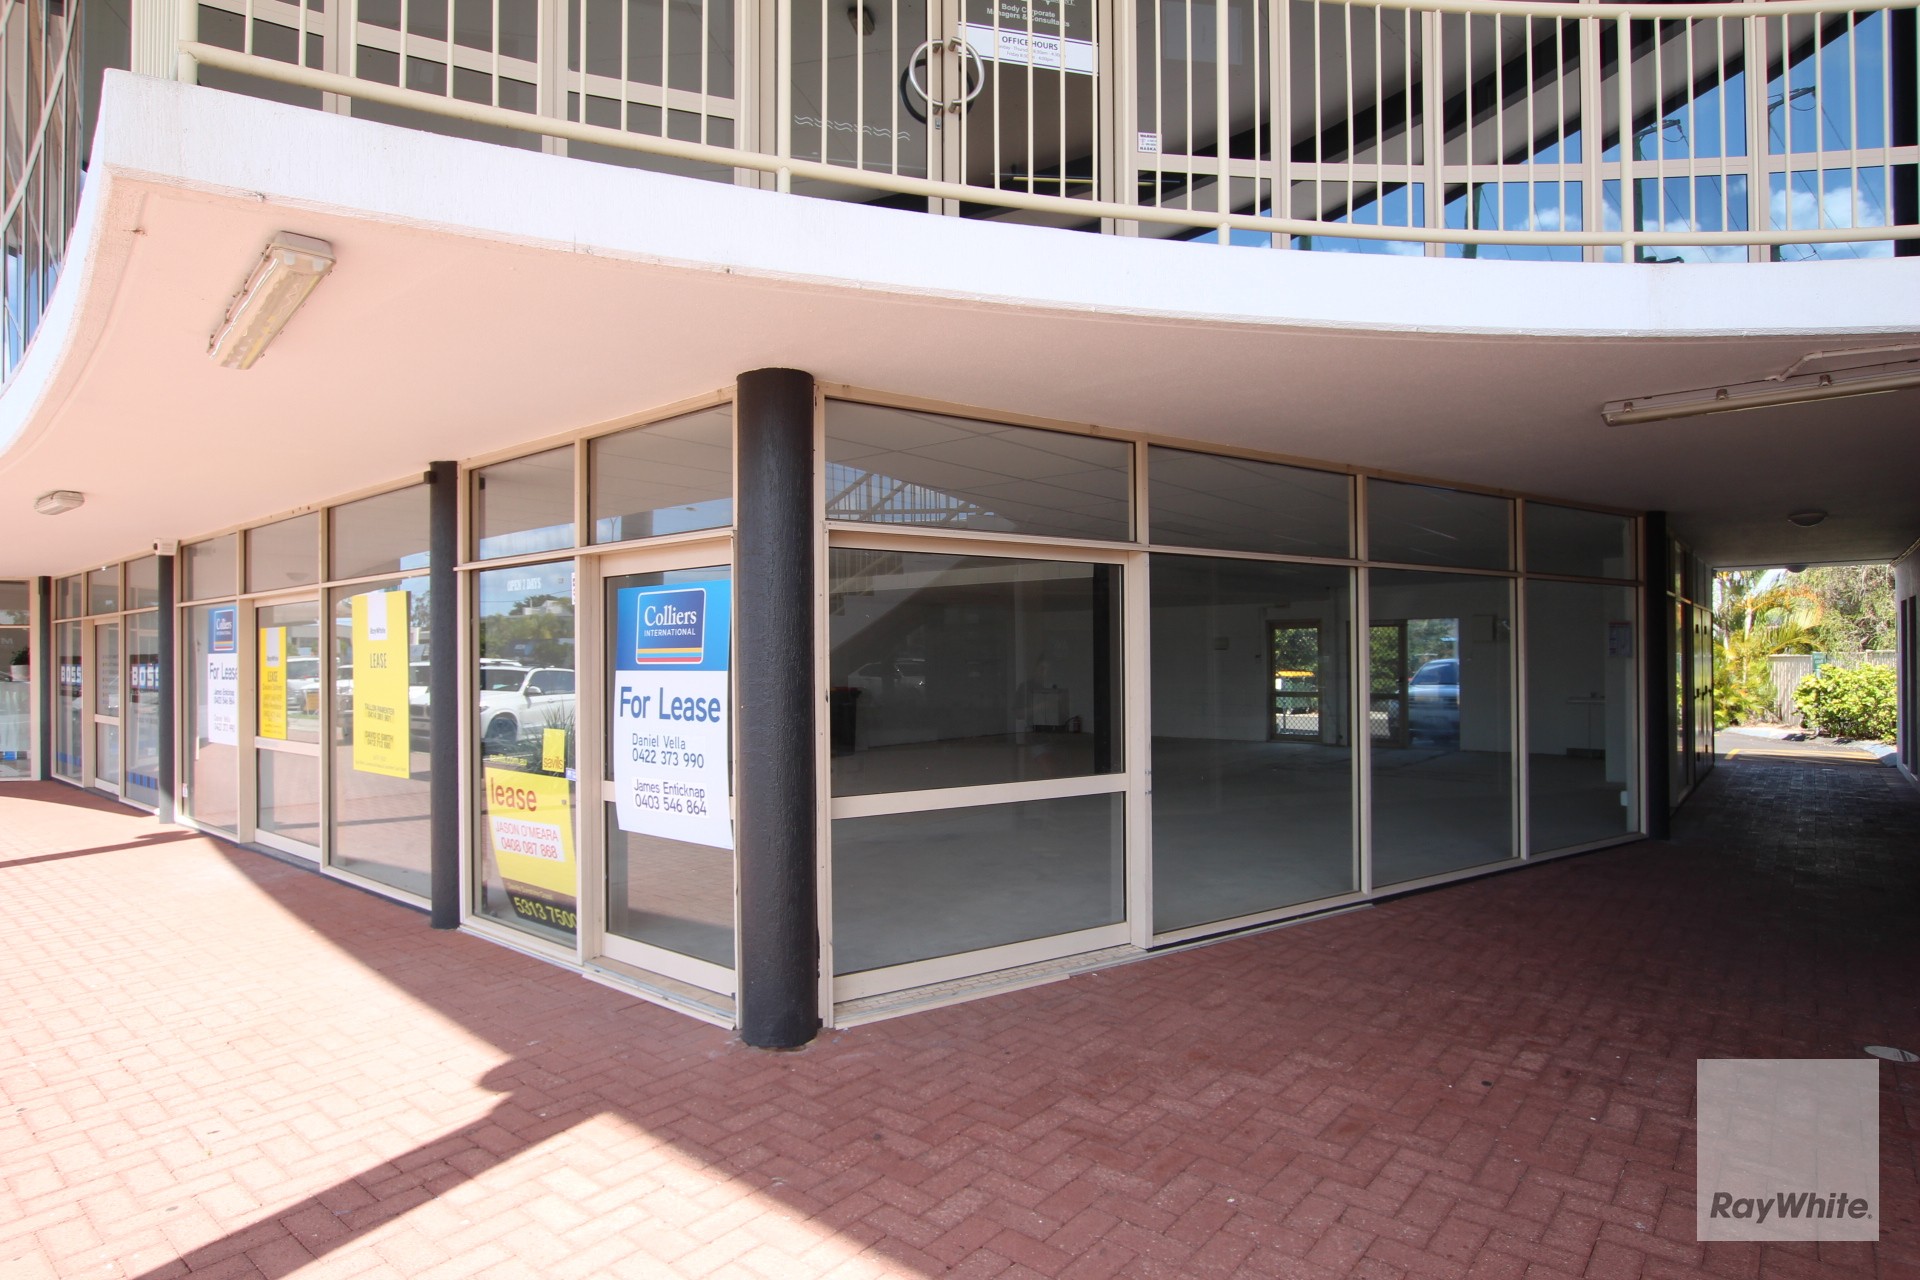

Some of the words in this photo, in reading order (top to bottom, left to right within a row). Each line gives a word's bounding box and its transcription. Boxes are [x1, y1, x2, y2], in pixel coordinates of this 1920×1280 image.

[1001, 3, 1020, 13] Body
[1001, 36, 1028, 47] OFFICE
[1032, 41, 1059, 51] HOURS
[644, 604, 697, 627] Colliers
[643, 628, 696, 637] INTERNATIONAL
[209, 663, 219, 680] For
[369, 653, 387, 669] LEASE
[619, 686, 651, 719] For
[658, 687, 721, 723] Lease
[632, 733, 659, 748] Daniel
[663, 735, 686, 750] Vella
[543, 755, 563, 769] savills
[632, 748, 657, 765] 0422
[660, 749, 679, 766] 373
[683, 752, 705, 769] 990
[490, 777, 537, 812] lease
[633, 778, 660, 795] James
[663, 780, 705, 799] Enticknap
[634, 794, 660, 811] 0403
[663, 796, 683, 814] 546
[686, 799, 708, 816] 864
[495, 820, 520, 836] JASON
[520, 825, 559, 842] O'MEARA
[501, 837, 522, 853] 0408
[522, 841, 538, 856] 087
[539, 844, 558, 859] 868
[513, 896, 547, 921] 5313
